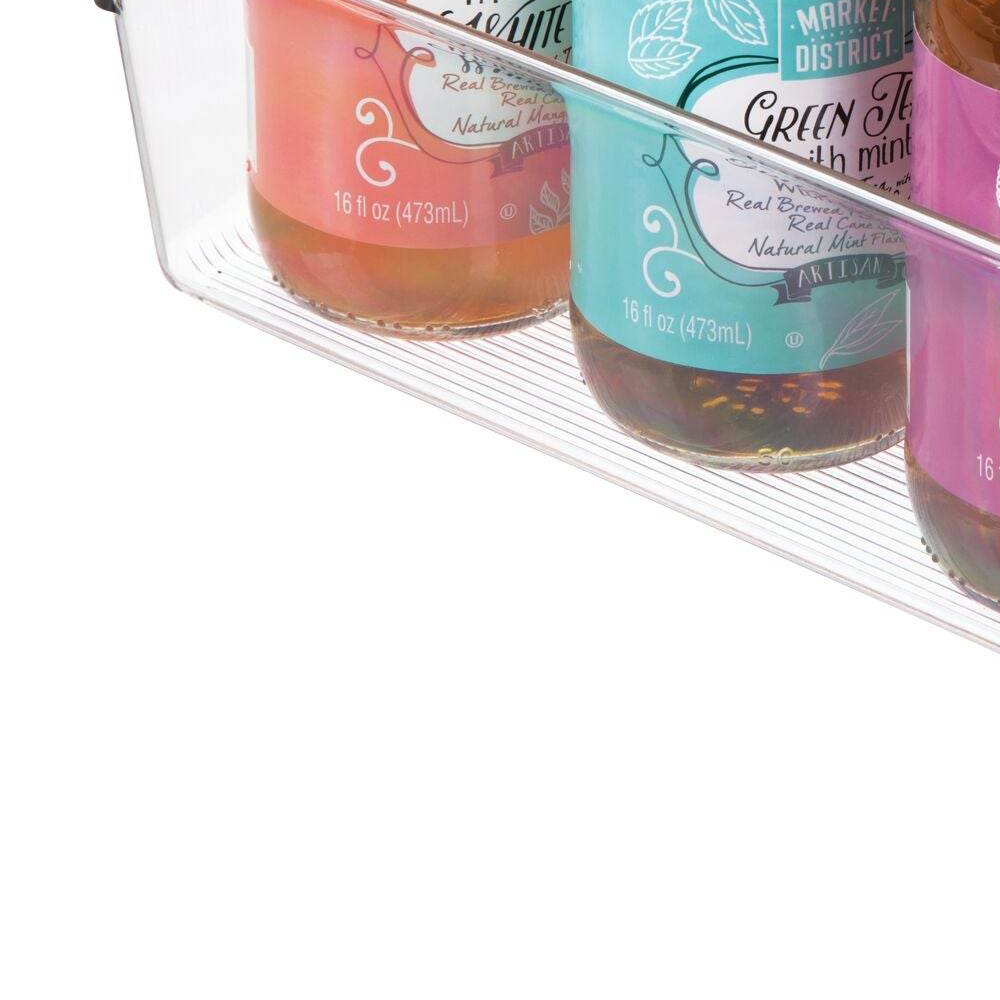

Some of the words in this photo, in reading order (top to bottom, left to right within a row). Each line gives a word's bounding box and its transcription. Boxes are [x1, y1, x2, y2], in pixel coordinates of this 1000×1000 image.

[796, 30, 895, 73] DISTRICT
[442, 73, 485, 93] Real
[501, 91, 538, 108] Real
[543, 94, 566, 105] Ca
[744, 90, 856, 143] GREEN
[863, 71, 913, 138] TE
[451, 113, 522, 136] Natural
[527, 104, 569, 126] Mang
[512, 127, 569, 160] ARTIS
[858, 123, 913, 172] mint
[333, 190, 352, 215] 16
[356, 195, 367, 218] fl
[371, 203, 391, 222] oz
[396, 201, 469, 229] (473mL)
[726, 189, 769, 211] Real
[788, 214, 830, 233] Real
[837, 216, 873, 231] Cane
[748, 234, 824, 258] Natural
[827, 229, 866, 253] Mint
[871, 232, 906, 247] Flav
[798, 256, 880, 289] ARTISAN
[622, 297, 640, 323] 16
[642, 304, 652, 329] fl
[657, 313, 675, 334] oz
[680, 315, 752, 351] (473mL)
[976, 454, 993, 481] 16
